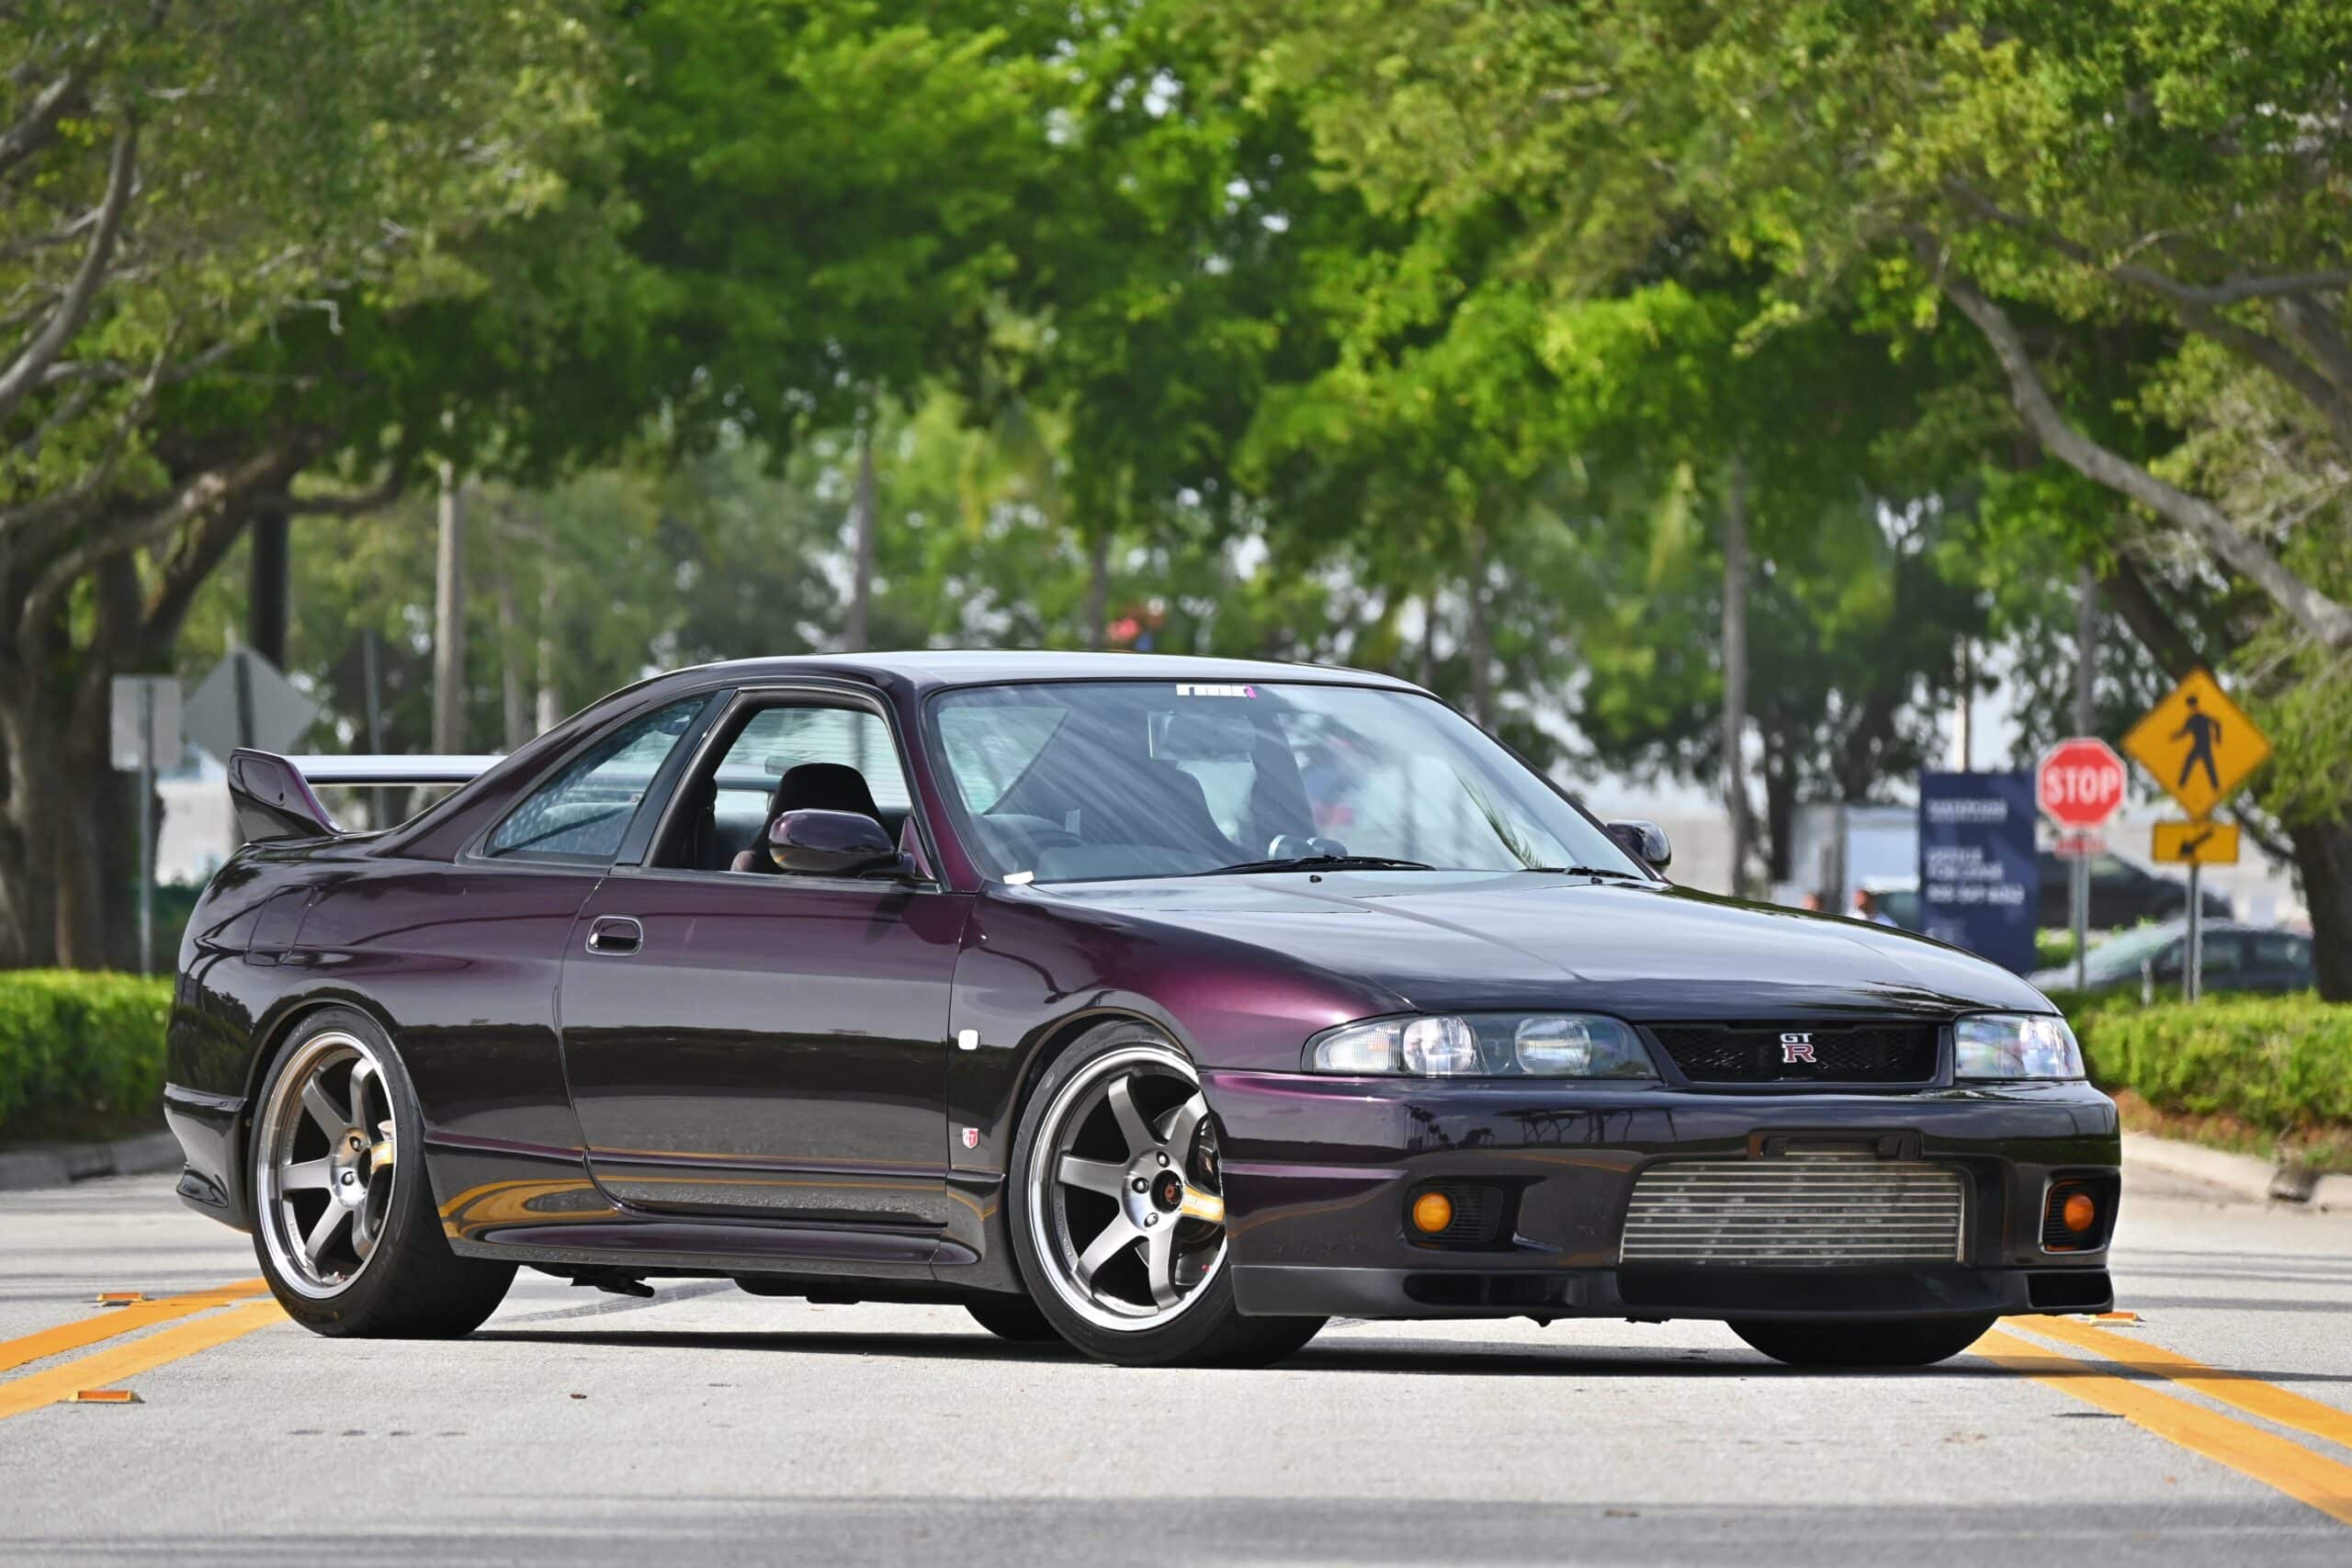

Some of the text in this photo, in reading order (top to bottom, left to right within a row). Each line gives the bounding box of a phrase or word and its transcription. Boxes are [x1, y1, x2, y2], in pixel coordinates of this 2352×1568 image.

[2045, 765, 2120, 805] STOP
[1780, 1032, 1814, 1043] GT
[1781, 1043, 1817, 1063] R
